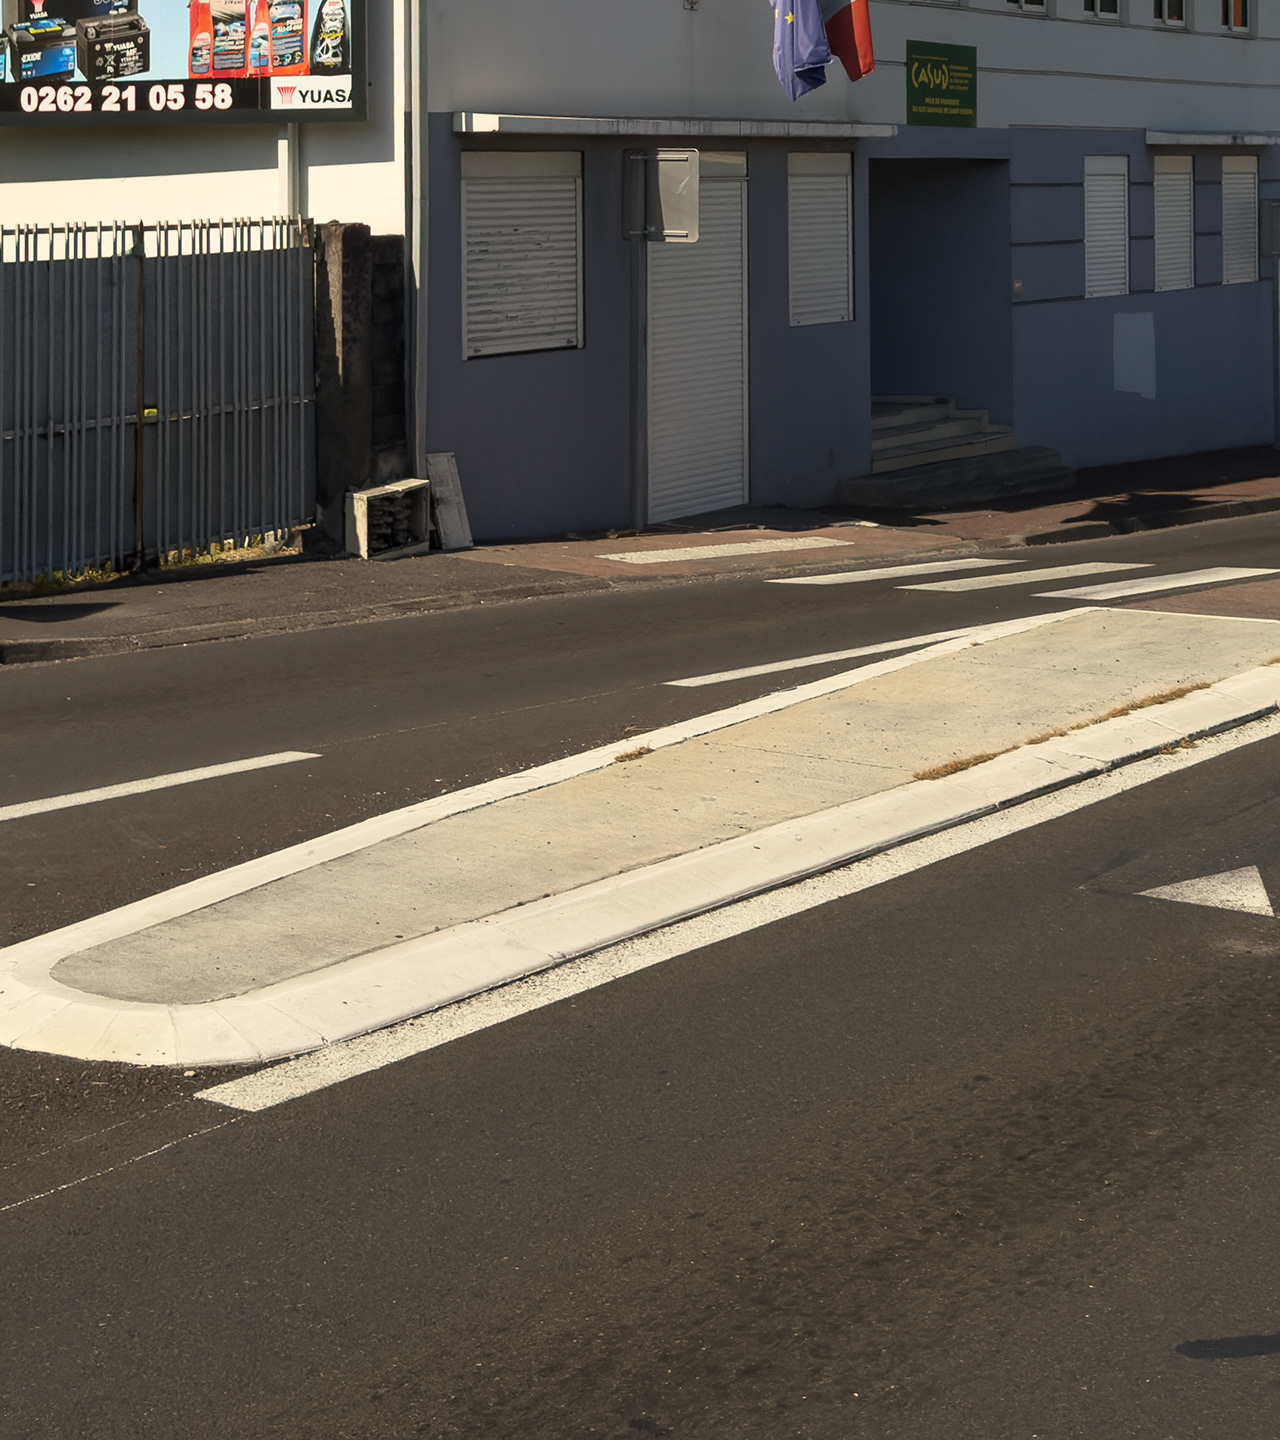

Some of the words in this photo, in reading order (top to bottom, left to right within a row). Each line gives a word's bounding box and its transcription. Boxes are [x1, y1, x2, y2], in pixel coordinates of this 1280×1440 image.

[113, 41, 135, 51] YUASA
[21, 85, 93, 113] 0262
[101, 85, 136, 112] 21
[149, 83, 185, 111] 05
[195, 83, 233, 110] 58
